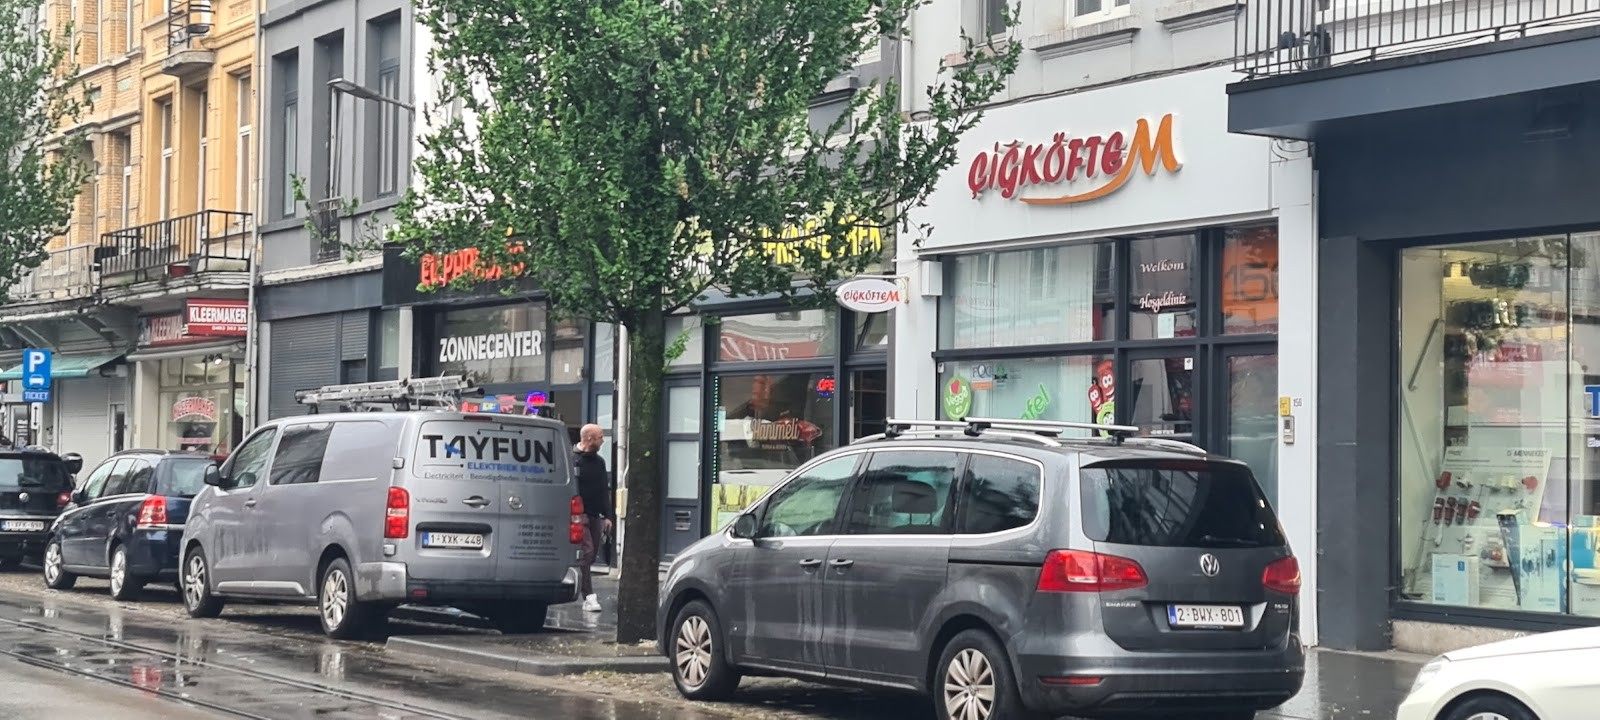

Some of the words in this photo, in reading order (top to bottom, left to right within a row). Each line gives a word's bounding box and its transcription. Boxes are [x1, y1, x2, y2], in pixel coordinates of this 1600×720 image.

[1140, 259, 1184, 272] Welkom
[189, 307, 247, 323] KLEERMAKER
[439, 330, 542, 362] ZONNECENTER
[29, 352, 45, 373] P
[25, 391, 49, 400] TICKET
[423, 435, 553, 465] TAYFUN
[430, 534, 482, 545] 1-XXK-448
[1177, 607, 1241, 623] 2-BWX-801
